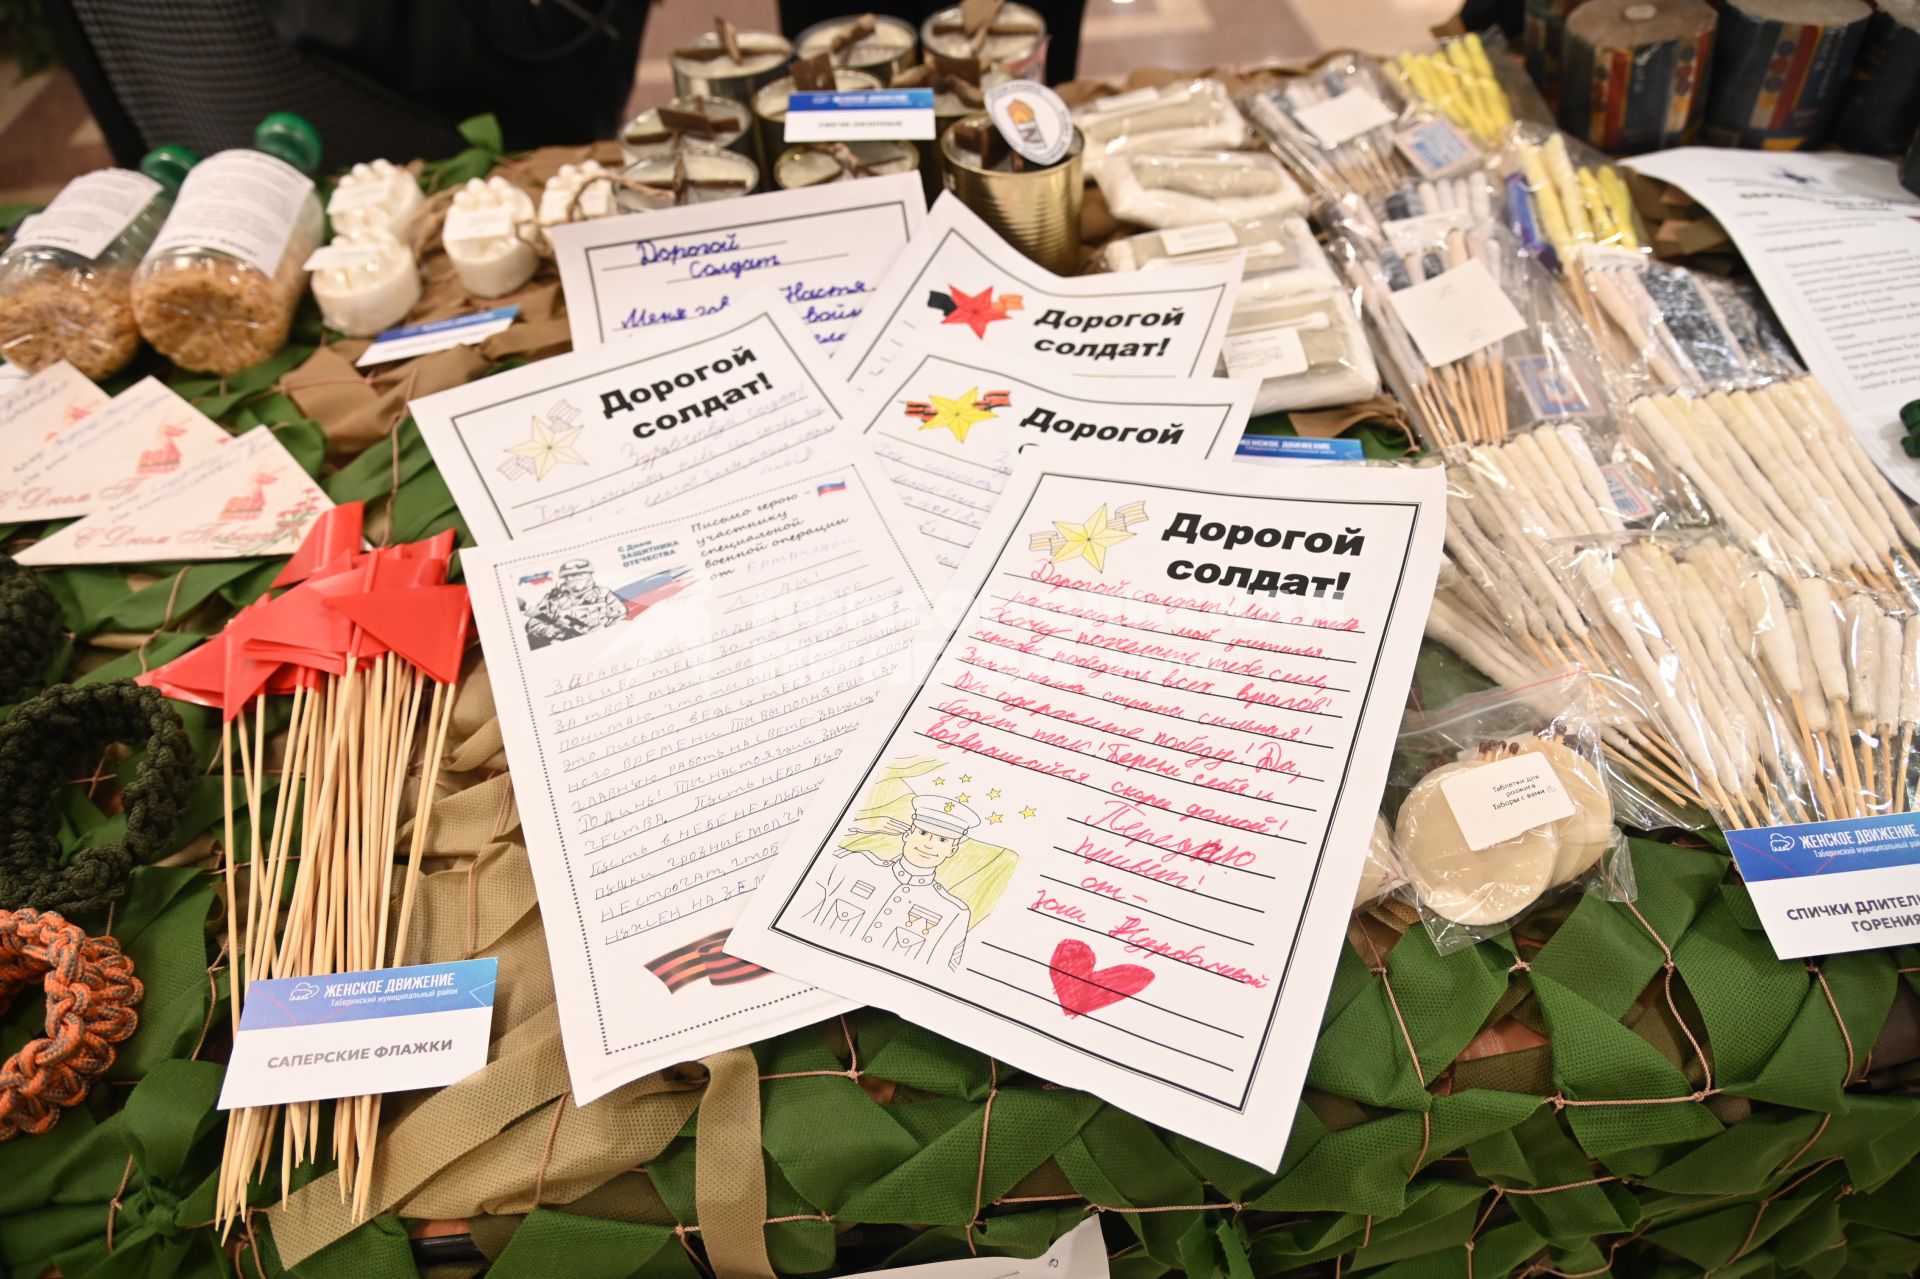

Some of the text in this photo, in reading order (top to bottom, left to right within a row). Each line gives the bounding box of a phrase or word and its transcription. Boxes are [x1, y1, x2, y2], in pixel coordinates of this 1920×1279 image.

[637, 233, 740, 267] Дорогой
[1034, 307, 1185, 333] Дорогой
[1034, 338, 1172, 360] солдат!
[600, 345, 757, 420] Дорогой
[632, 371, 774, 439] солдат!
[1021, 408, 1185, 446] Дорогой
[691, 509, 752, 533] Письмо
[757, 493, 798, 513] герою
[696, 510, 788, 548] участнику
[701, 518, 804, 558] специальной
[705, 517, 849, 570] военной операции
[1161, 512, 1365, 557] Дорогой
[621, 541, 680, 560] ЗАЩИТНИКА
[623, 549, 677, 568] ОТЕЧЕСТВА
[710, 568, 735, 582] от
[1031, 558, 1131, 594] Дорогой
[1166, 559, 1351, 600] солдат!
[990, 606, 1073, 644] Хочу
[1075, 632, 1200, 665] пожелать
[1208, 657, 1265, 678] тебе
[1053, 650, 1153, 682] победить
[1161, 669, 1216, 695] всех
[1236, 682, 1333, 715] врагов!
[1102, 690, 1185, 720] страна
[1152, 732, 1255, 771] победу!
[1491, 773, 1541, 794] Таблетки для
[1505, 782, 1537, 799] розжига
[1491, 789, 1547, 811] Таборы с вами
[1799, 830, 1856, 849] ЖЕНСКОЕ
[1855, 823, 1919, 845] ДВИЖЕНИЕ
[1815, 846, 1857, 859] Таборинский
[1857, 841, 1909, 855] муниципальный
[1786, 901, 1853, 921] СПИЧКИ
[1851, 913, 1920, 933] ГОРЕНИЯ
[323, 972, 455, 998] ЖЕНСКОЕ ДВИЖЕНИЕ
[331, 987, 458, 1008] Таборинский муниципальный район
[267, 1039, 453, 1069] САПЕРСКИЕ ФЛАЖКИ
